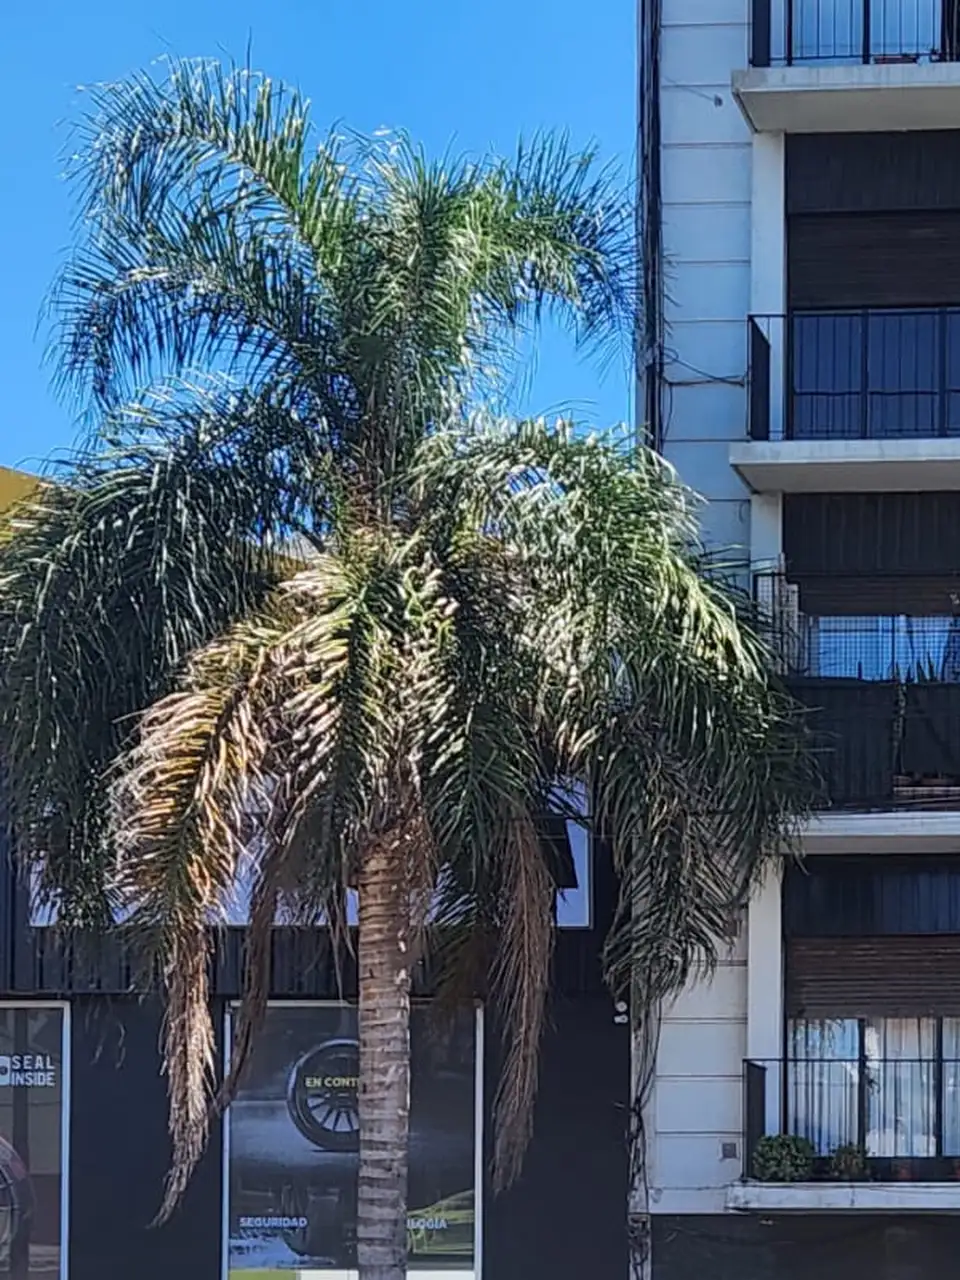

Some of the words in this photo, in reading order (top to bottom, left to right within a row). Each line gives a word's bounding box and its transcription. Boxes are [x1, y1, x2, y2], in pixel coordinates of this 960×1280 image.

[11, 1054, 55, 1070] SEAL
[11, 1071, 56, 1087] INSIDE
[305, 1077, 321, 1087] EN
[239, 1216, 308, 1228] SEGURIDAD
